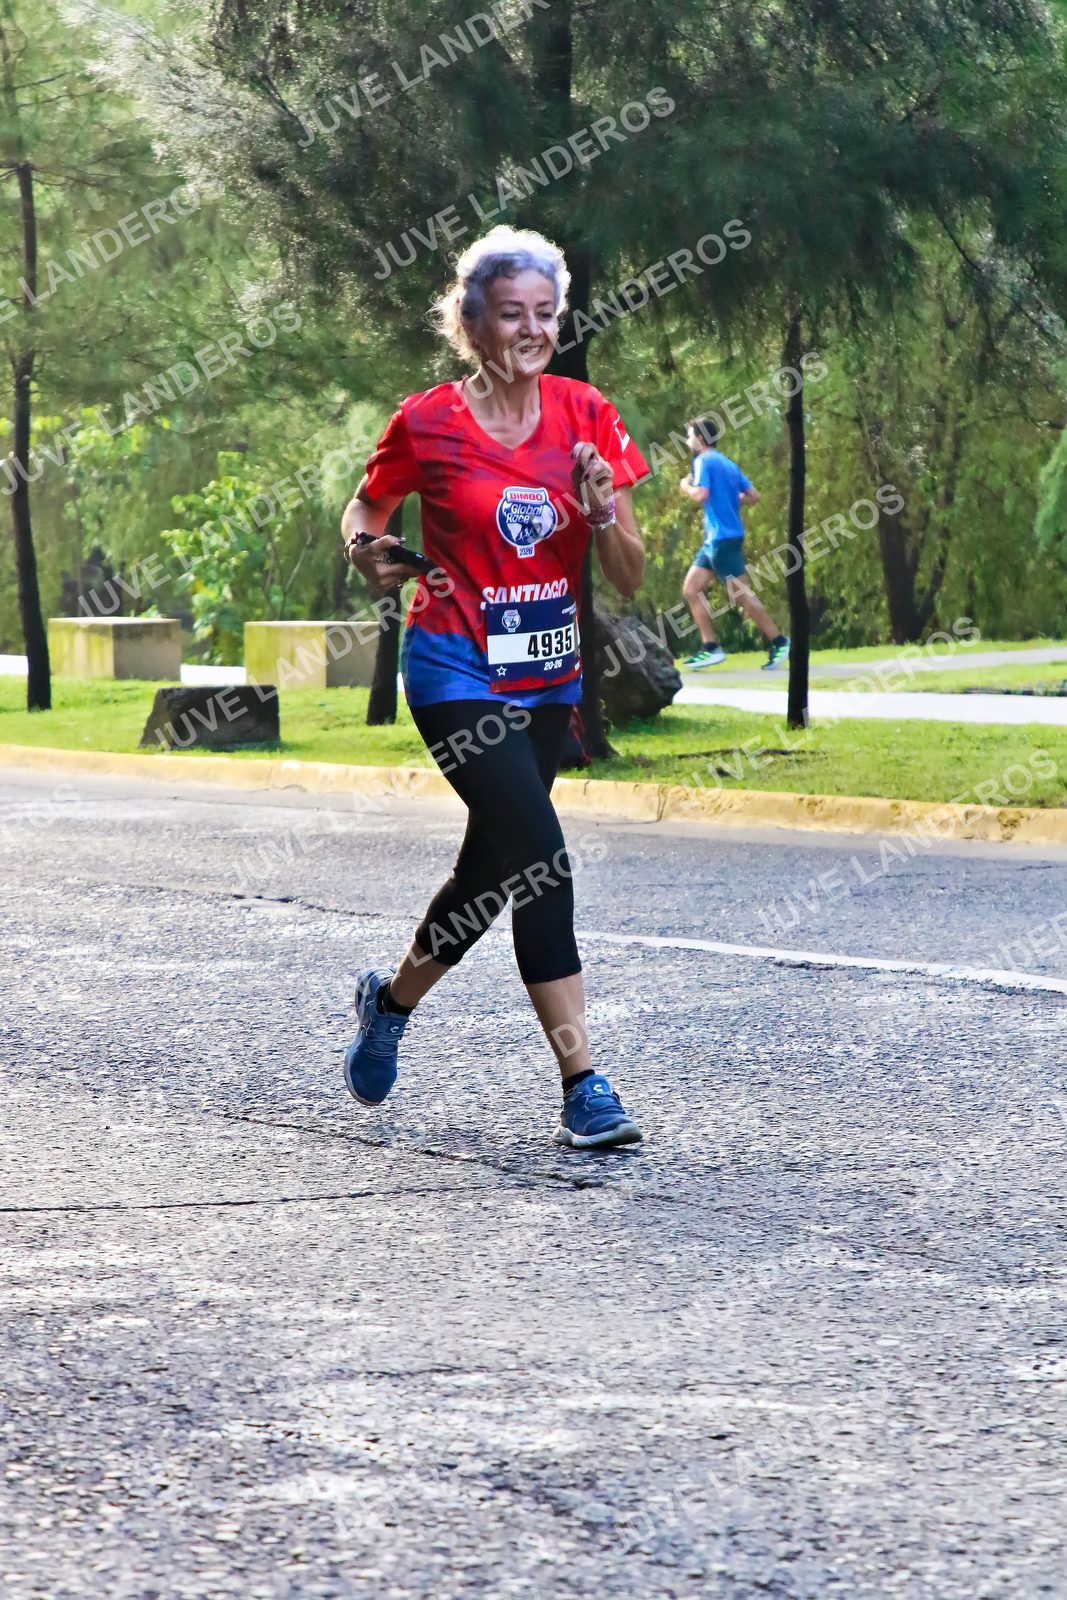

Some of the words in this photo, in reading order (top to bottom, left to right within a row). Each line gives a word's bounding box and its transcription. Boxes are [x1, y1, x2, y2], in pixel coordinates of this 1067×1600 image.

[509, 492, 543, 501] BIMBO
[511, 503, 543, 516] Global
[505, 512, 530, 524] Race
[519, 546, 533, 557] 2026
[480, 577, 569, 611] SANTIAGO
[527, 627, 573, 659] 4935
[544, 659, 563, 671] 20-26
